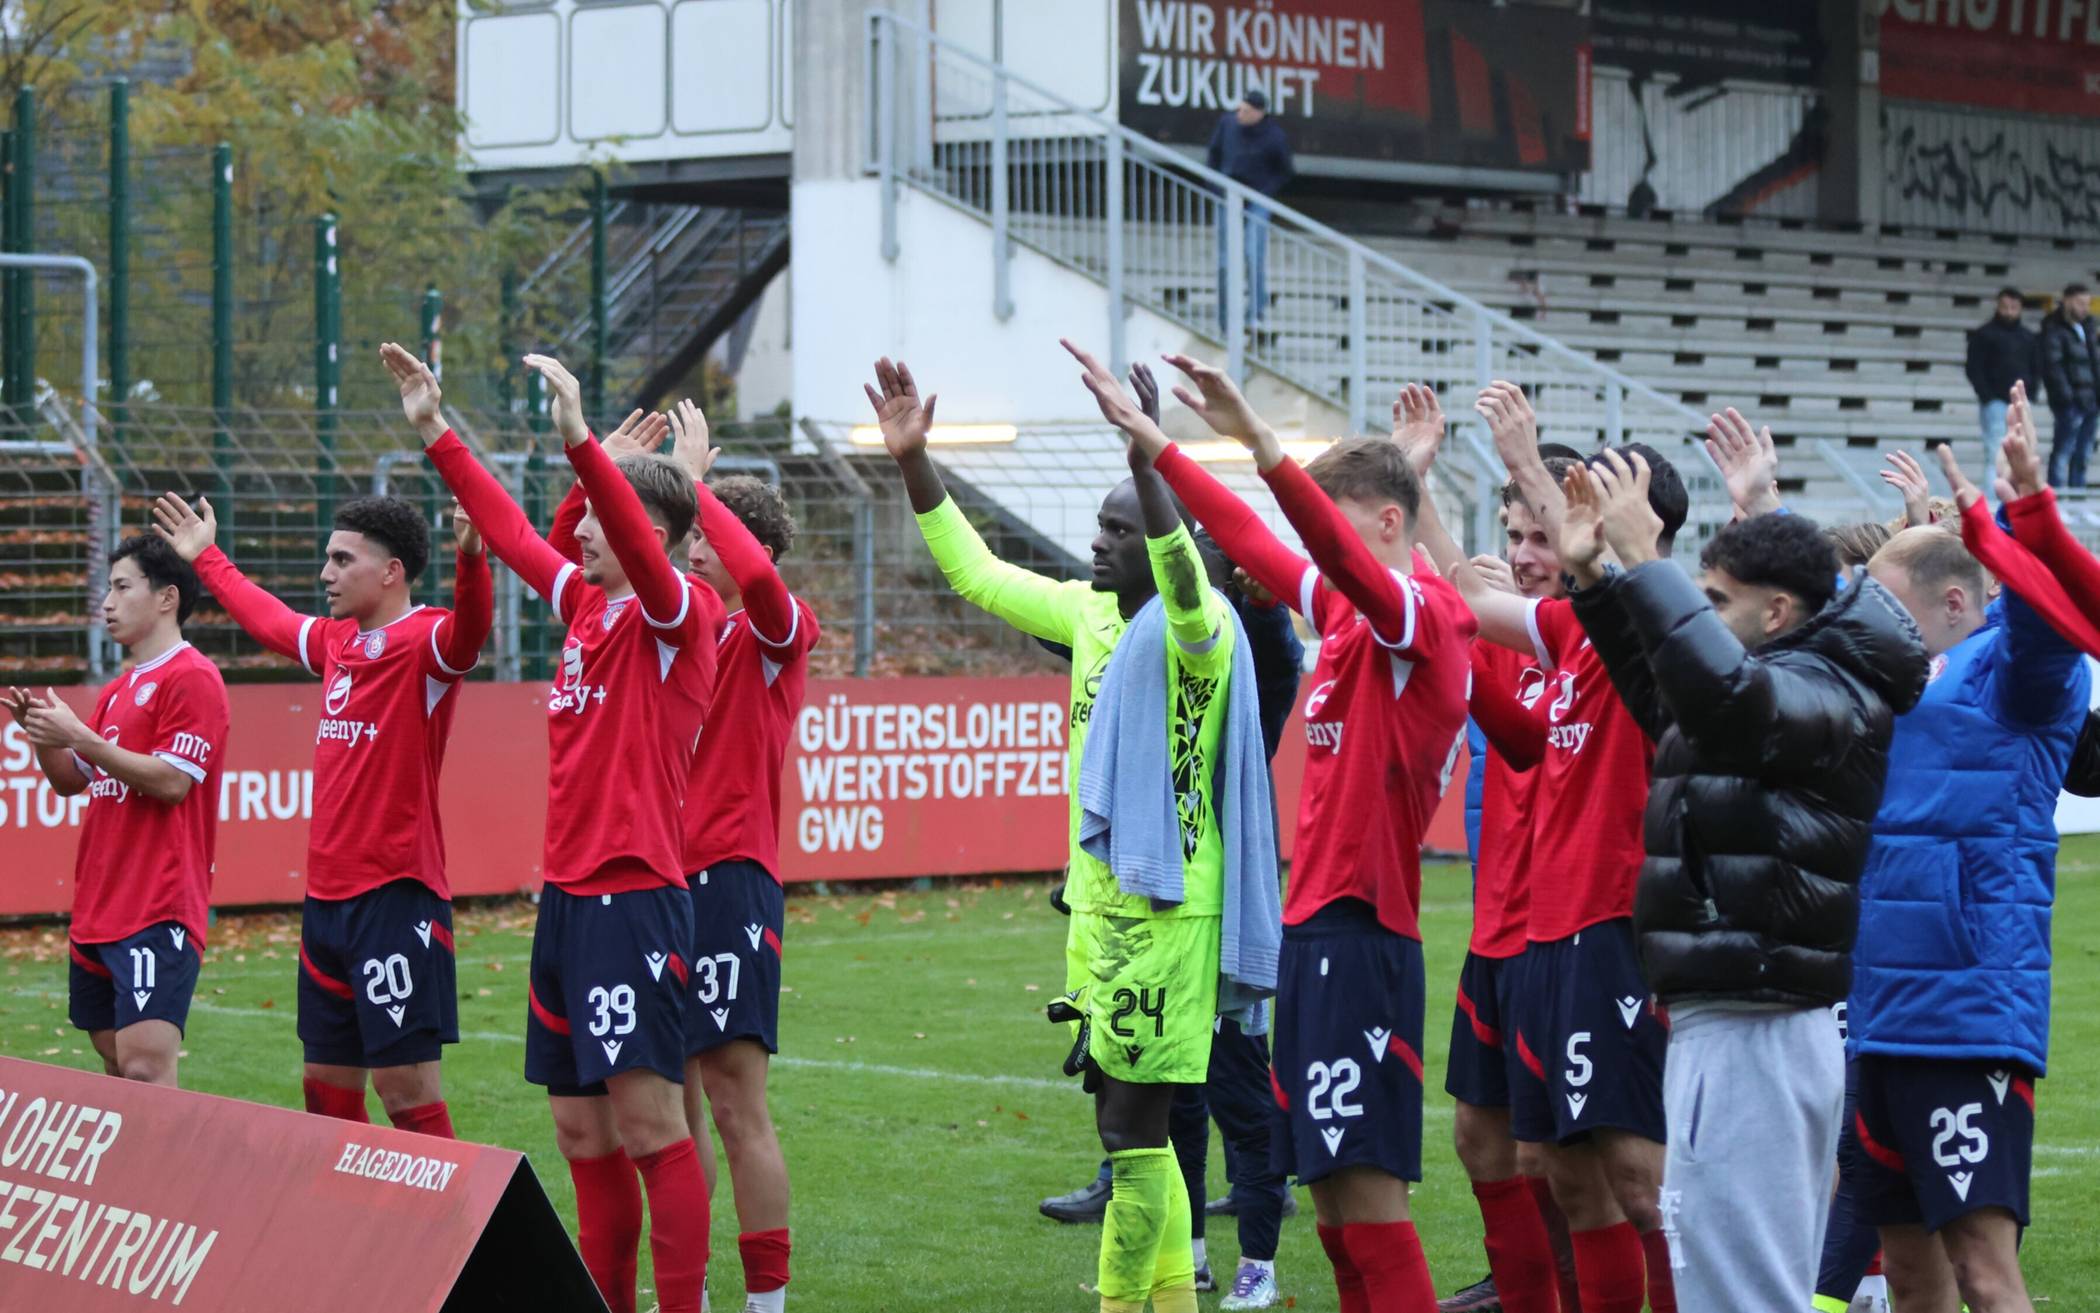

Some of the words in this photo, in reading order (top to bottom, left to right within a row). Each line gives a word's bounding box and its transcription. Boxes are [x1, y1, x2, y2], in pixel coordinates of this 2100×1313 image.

[1136, 0, 1216, 54] WIR
[1227, 0, 1386, 70] KÖNNEN
[1136, 54, 1320, 118] ZUKUNFT
[799, 693, 1065, 752] GÜTERSLOHER
[798, 805, 884, 854] GWG
[129, 947, 156, 988] 11
[363, 953, 414, 1005] 20
[696, 952, 741, 1004] 37
[588, 984, 637, 1037] 39
[1110, 987, 1167, 1038] 24
[1565, 1032, 1594, 1087] 5
[1307, 1057, 1365, 1121] 22
[1930, 1102, 1989, 1168] 25
[334, 1142, 459, 1193] HAGEDORN
[0, 1180, 220, 1306] FZENTRUM
